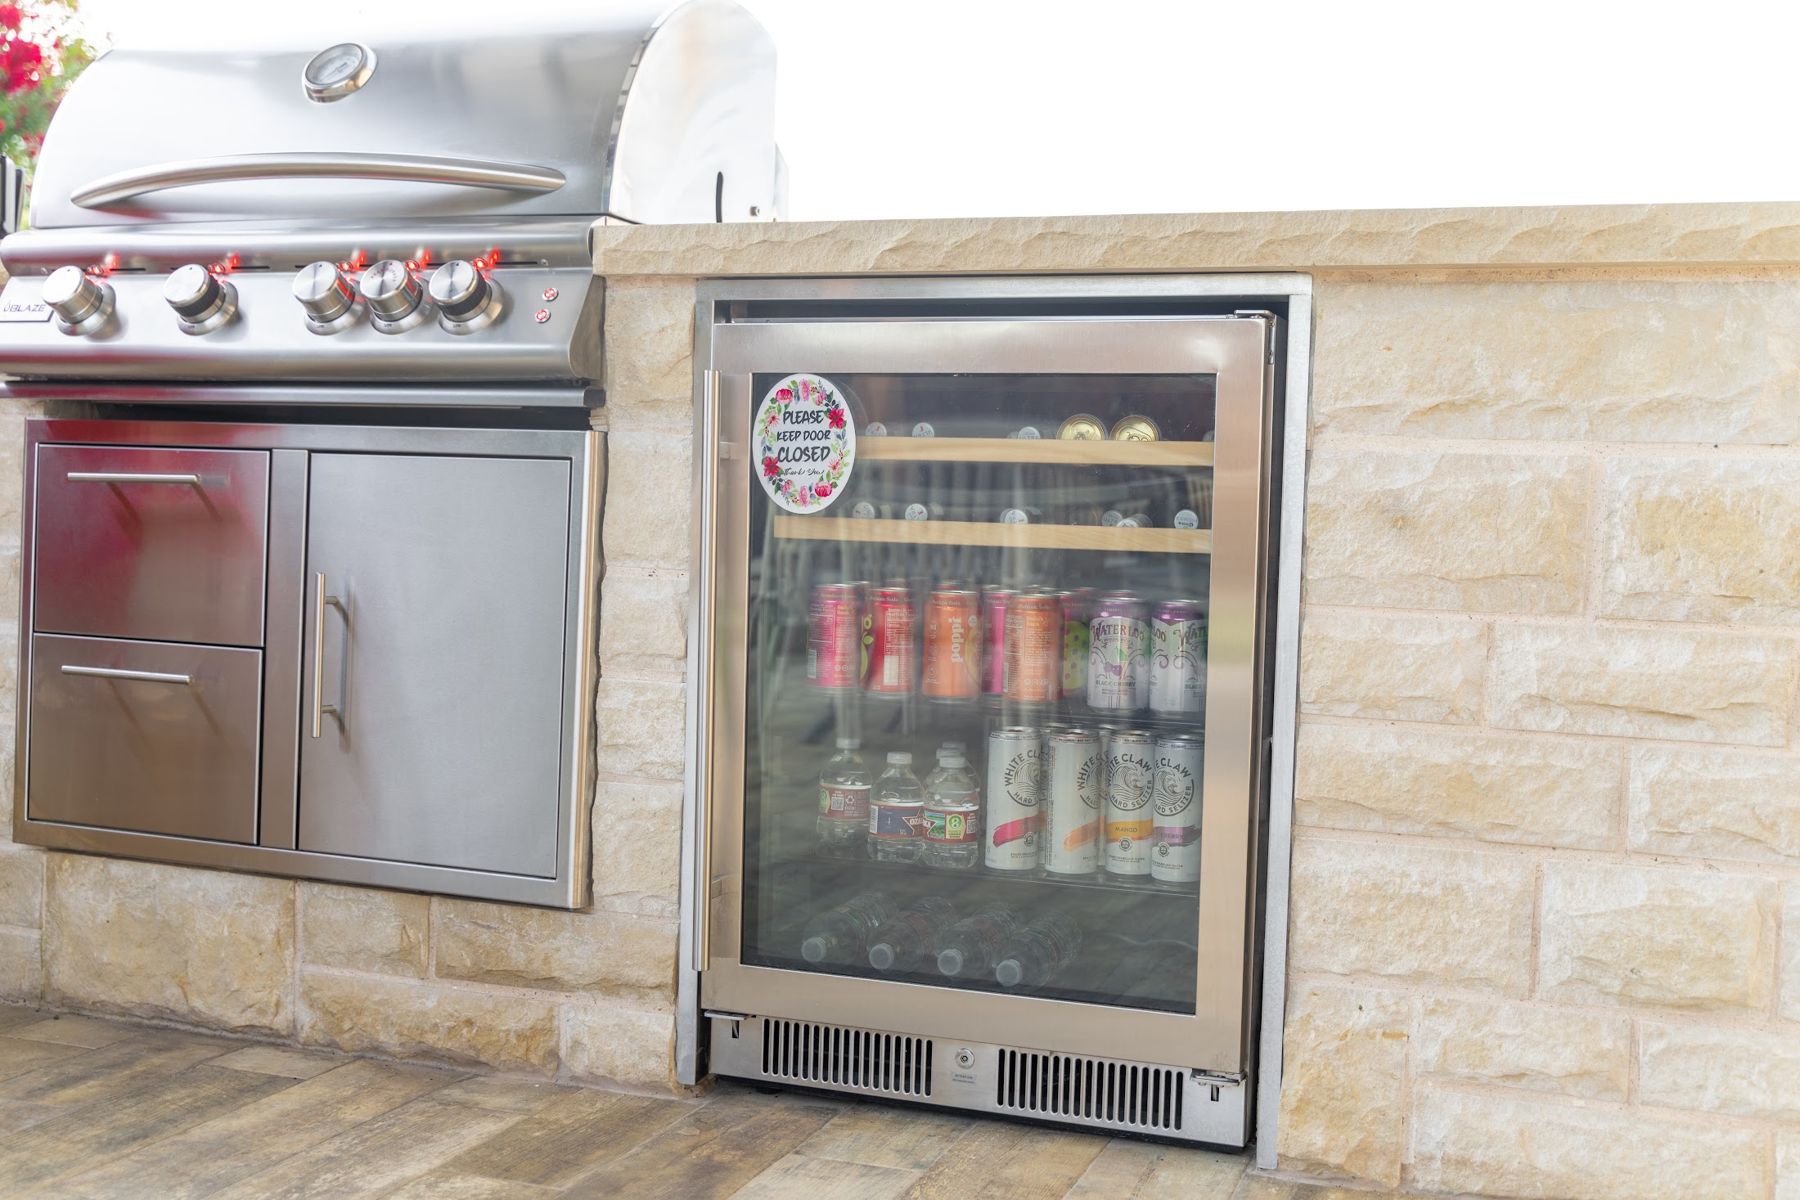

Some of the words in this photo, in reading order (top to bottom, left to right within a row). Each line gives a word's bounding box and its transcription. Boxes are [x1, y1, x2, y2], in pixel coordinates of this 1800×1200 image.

[9, 304, 46, 313] BLAZE
[783, 410, 824, 425] PLEASE
[776, 430, 801, 442] KEEP
[803, 430, 831, 441] DOOR
[777, 446, 831, 463] CLOSED
[950, 616, 964, 662] poppi
[1003, 753, 1025, 787] WHITE
[1121, 753, 1153, 772] CLAW
[1160, 757, 1192, 778] CLAW
[1077, 756, 1096, 791] WHITE
[1013, 791, 1033, 804] HARD
[1110, 794, 1128, 808] HARD
[1131, 780, 1153, 808] SELTZER
[1154, 803, 1166, 813] ARD
[1168, 785, 1192, 814] SELTZER
